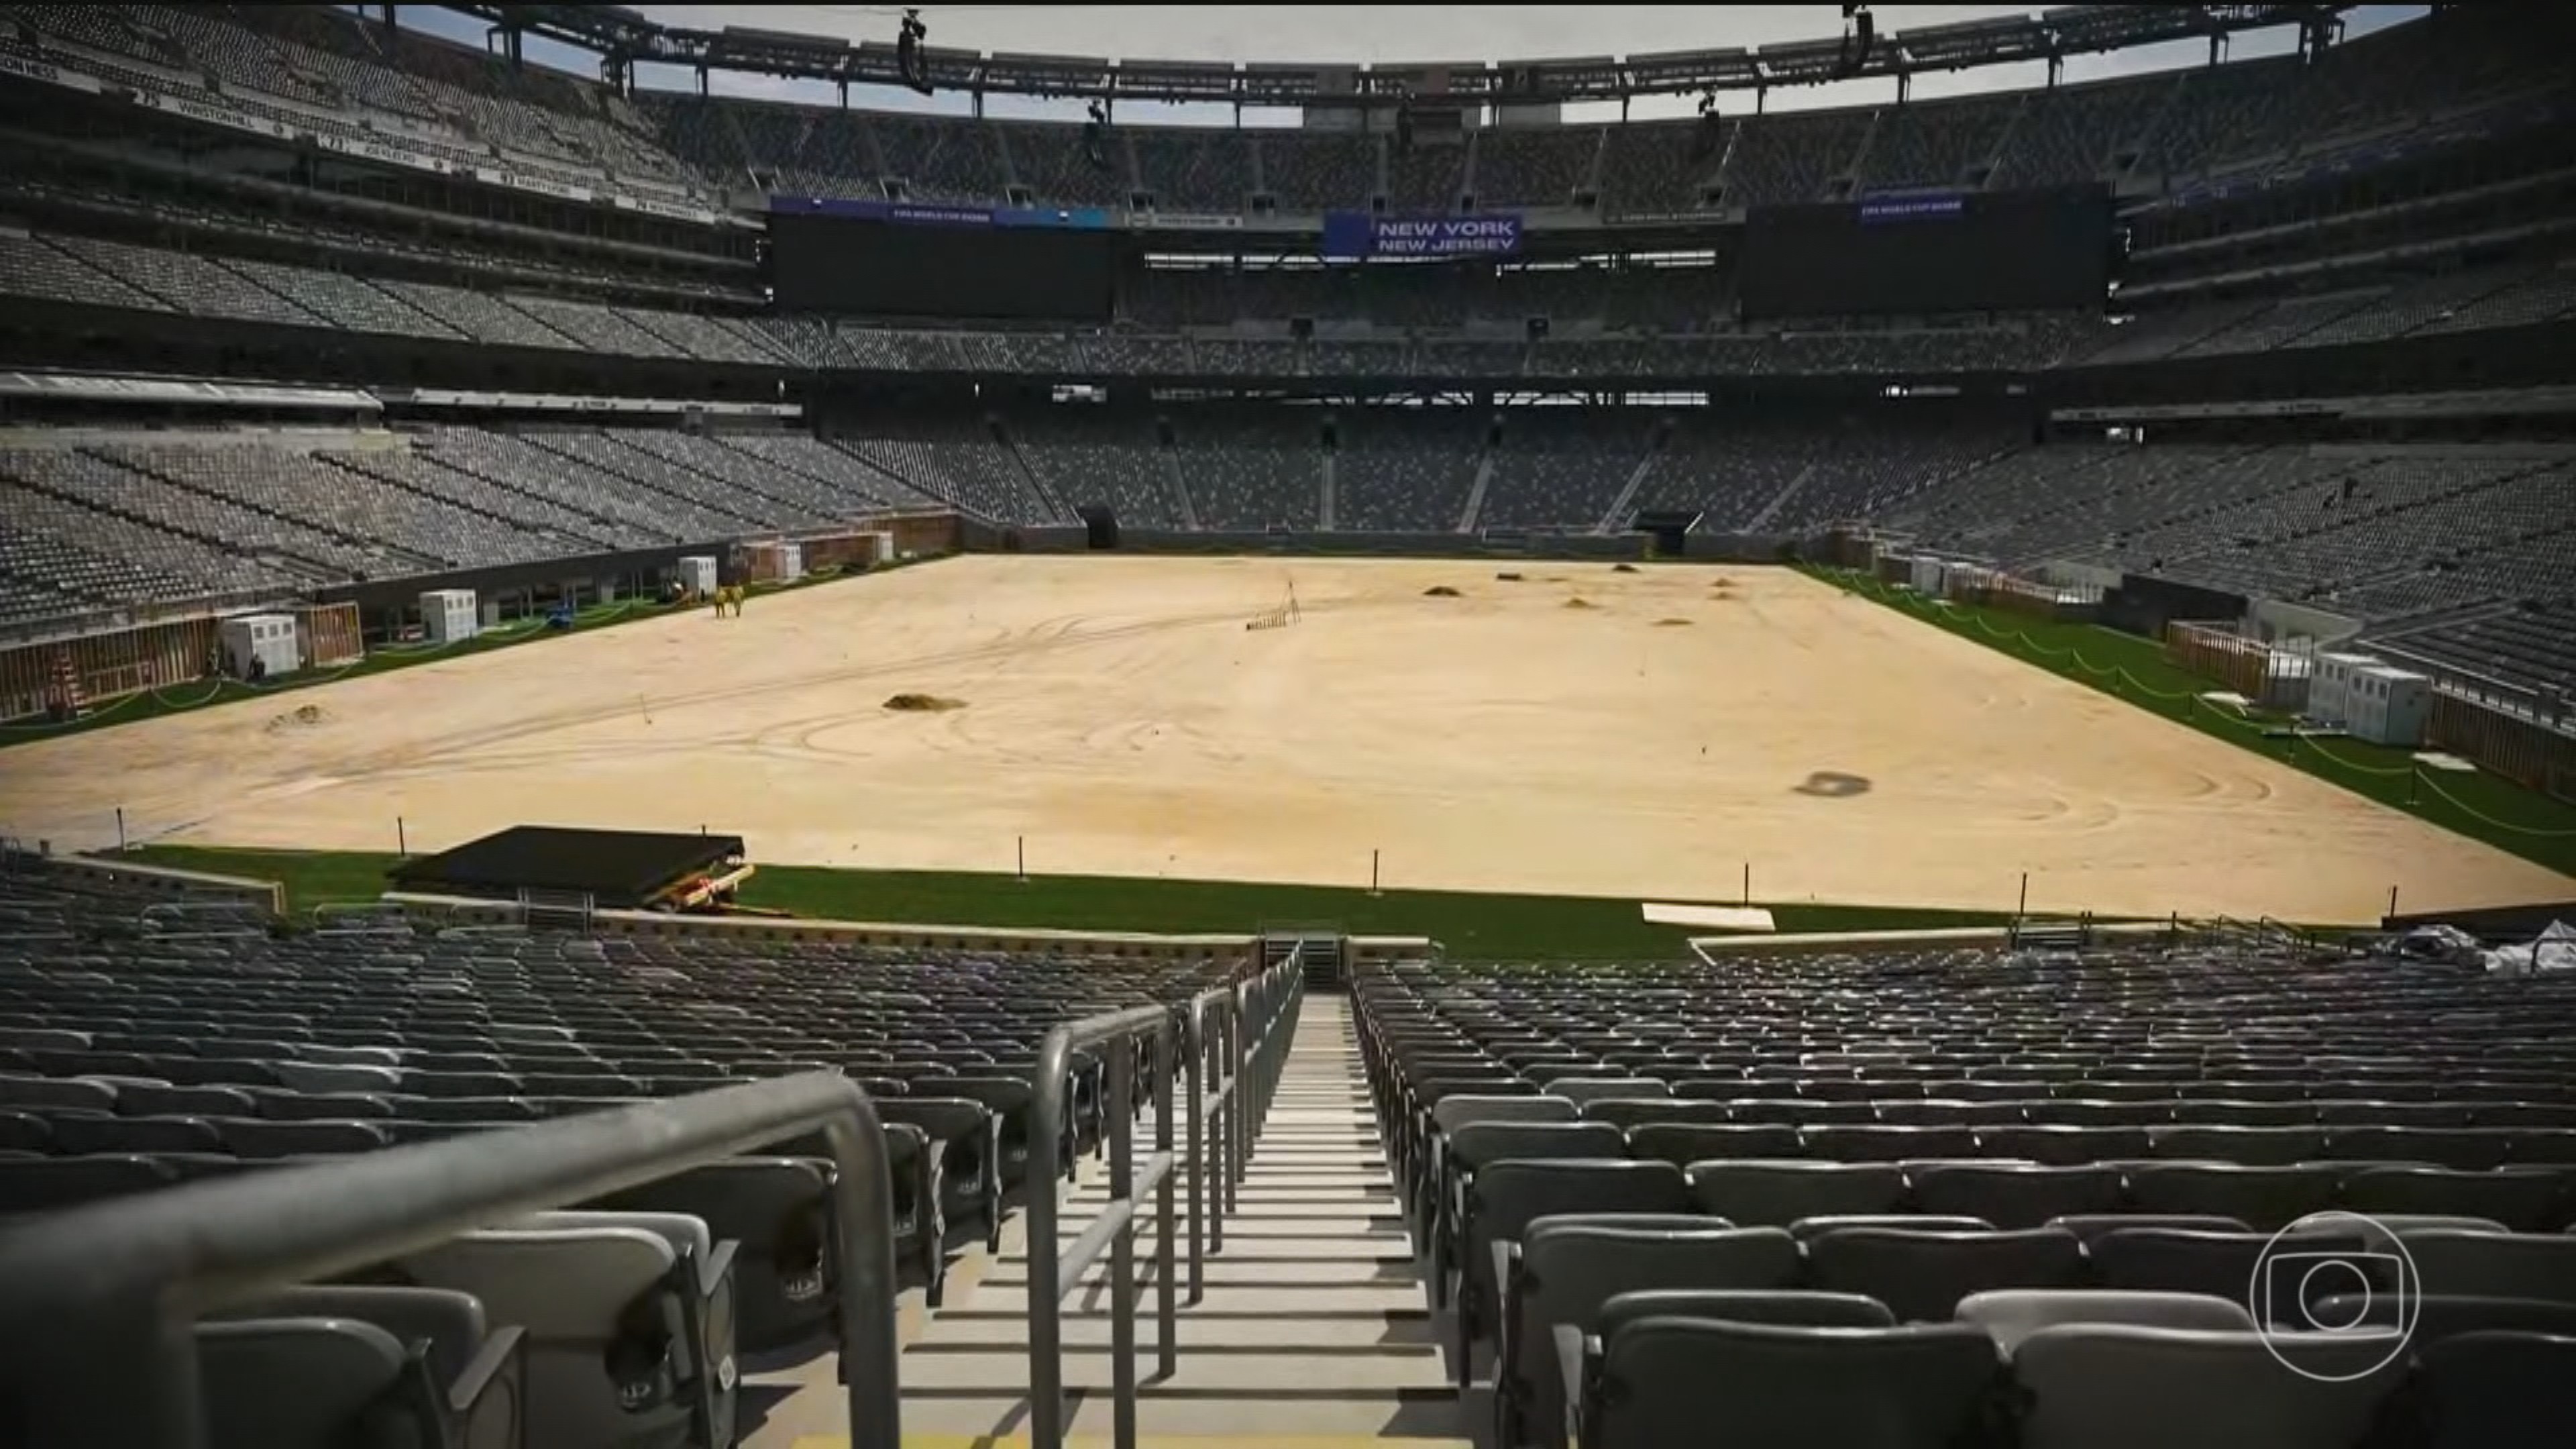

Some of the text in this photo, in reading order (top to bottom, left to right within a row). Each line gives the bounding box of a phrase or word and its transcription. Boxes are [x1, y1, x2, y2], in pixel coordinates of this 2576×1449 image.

[1379, 221, 1514, 236] NEW YORK
[1379, 238, 1514, 252] NEW JERSEY
